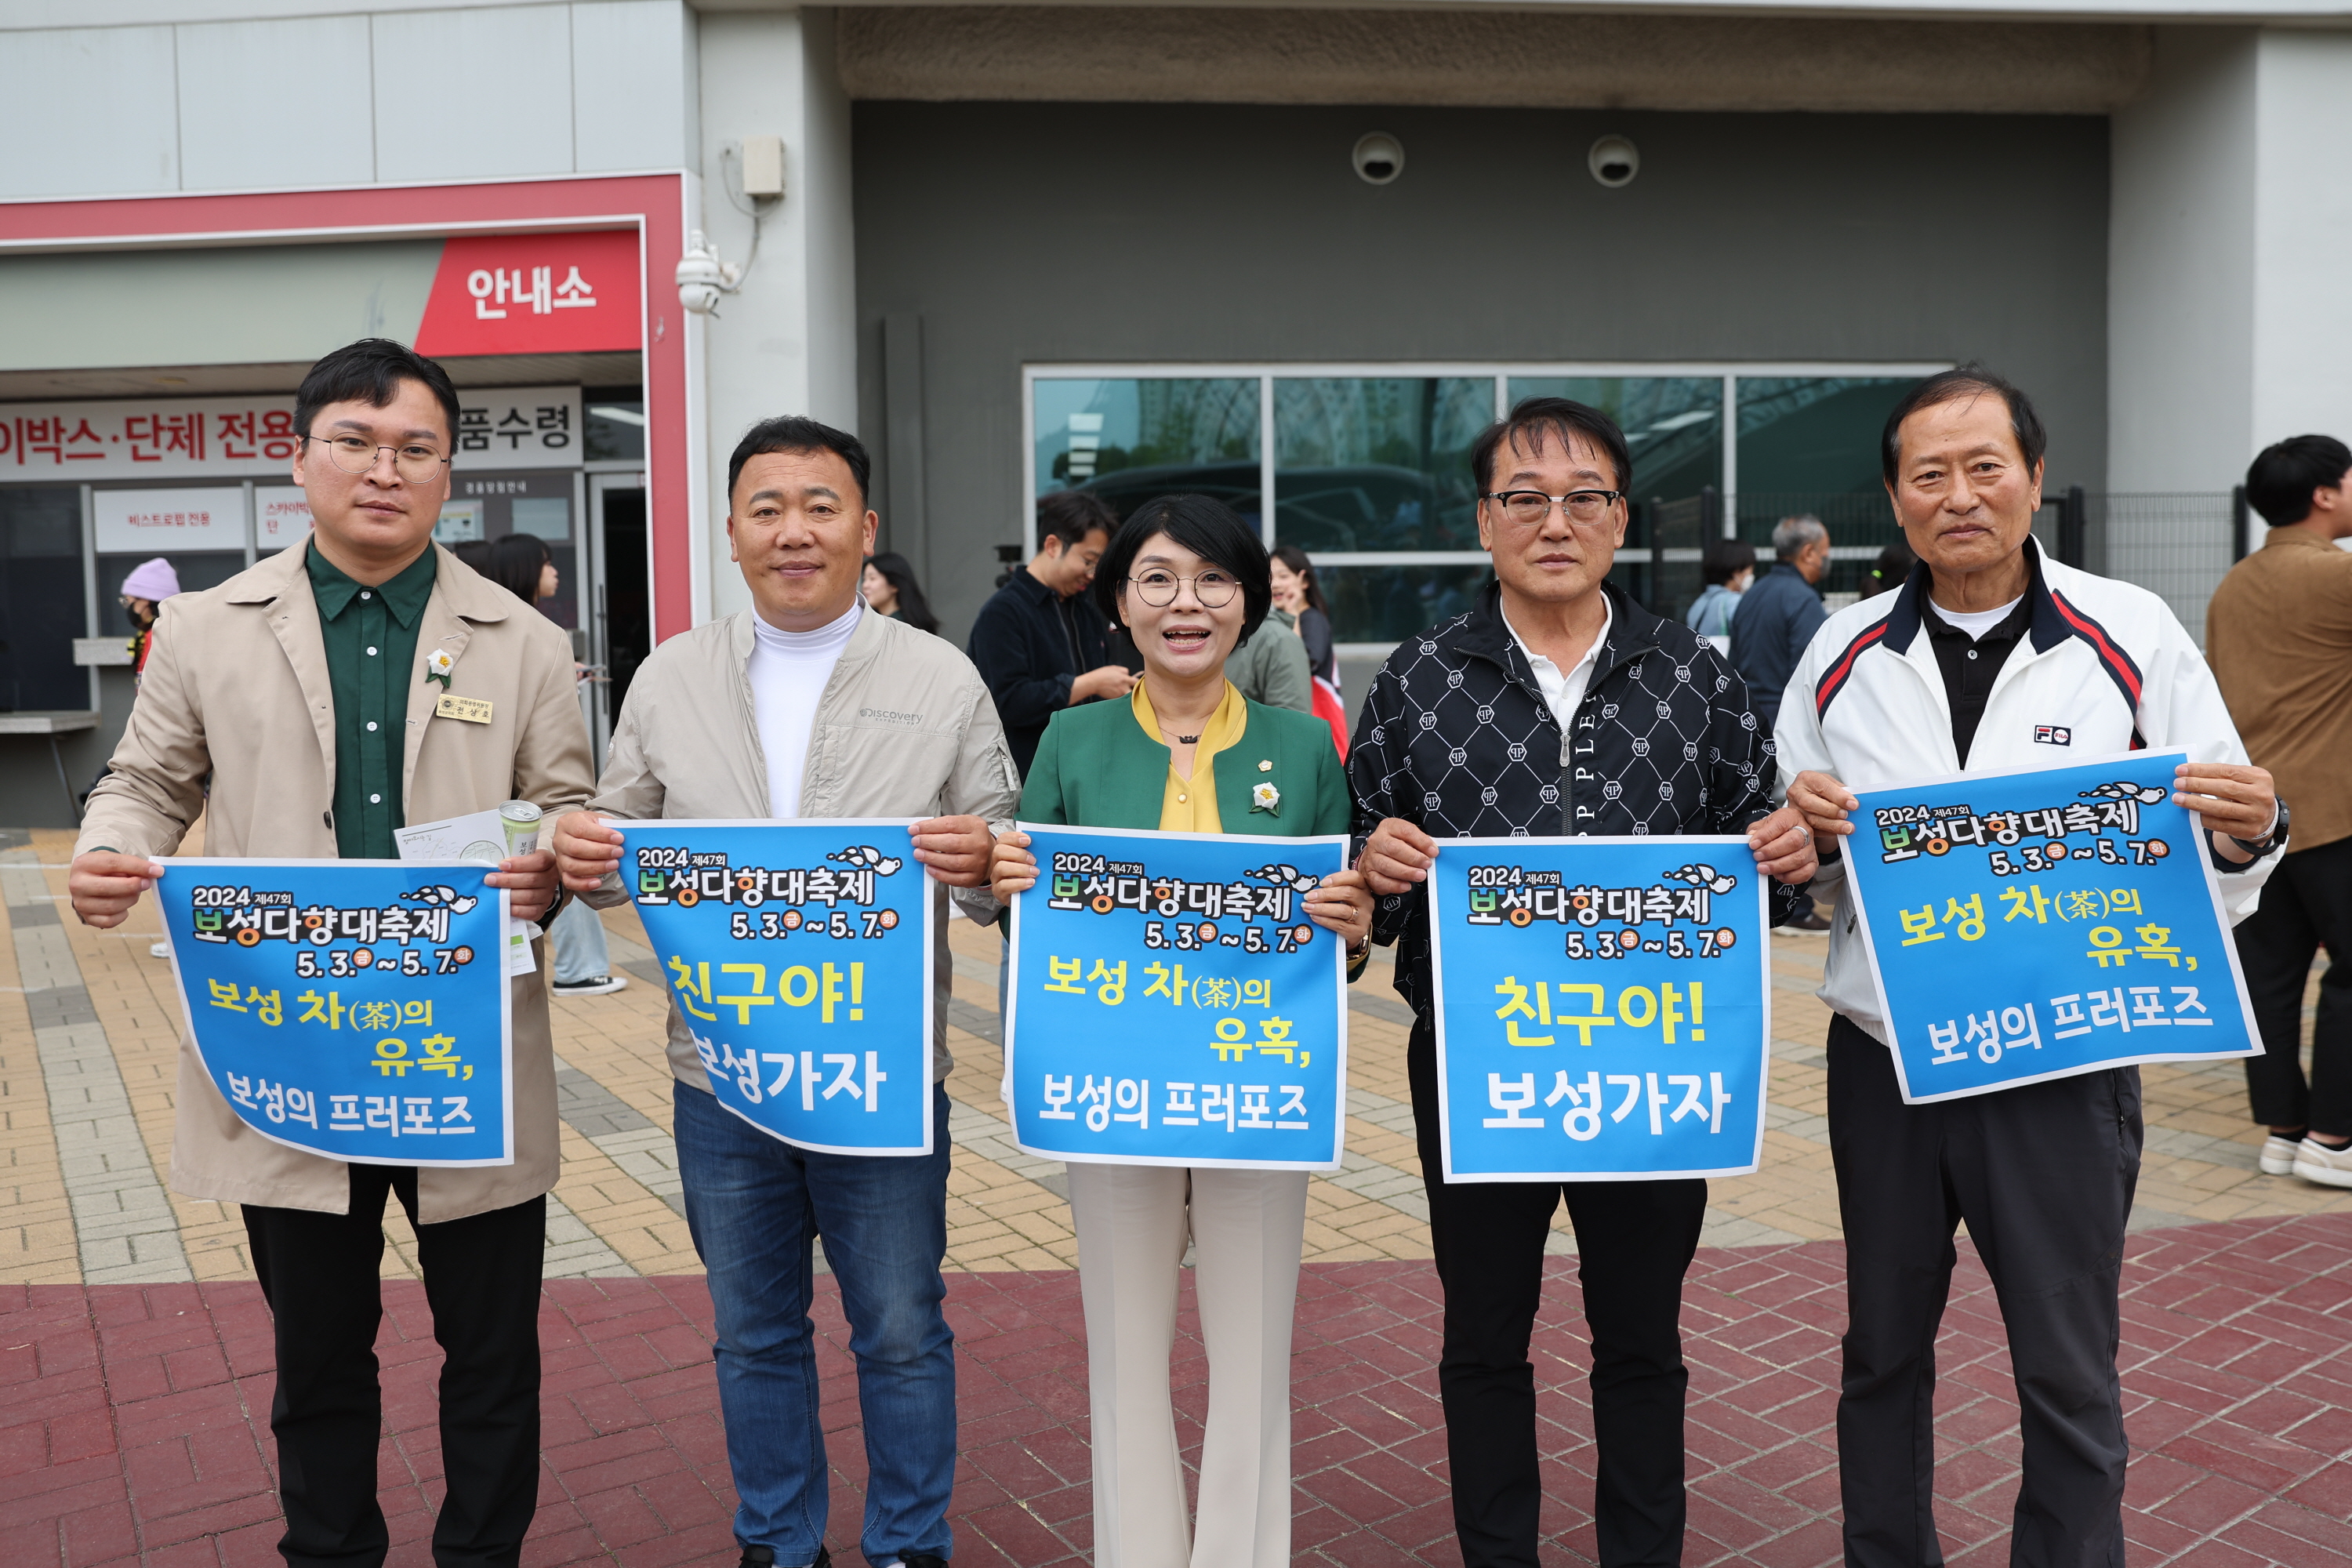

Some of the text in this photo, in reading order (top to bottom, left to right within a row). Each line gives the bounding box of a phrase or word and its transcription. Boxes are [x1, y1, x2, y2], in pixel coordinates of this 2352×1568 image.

[466, 264, 597, 320] 안내소
[216, 409, 295, 460] 전용
[460, 405, 571, 451] 품수령
[875, 717, 915, 726] EXPEDITION
[1876, 806, 1970, 826] 2024 제47회
[1881, 800, 2139, 863] 보성다향대축제
[637, 849, 727, 868] 2024 제47회
[1054, 854, 1143, 875] 2024 제47회
[1470, 867, 1560, 887] 2024 제47회
[193, 887, 292, 906] 2024 제47회
[637, 868, 874, 907] 보성다향대축제
[1049, 876, 1292, 922] 보성다향대축제
[1468, 887, 1709, 926] 보성다향대축제
[194, 906, 450, 946] 보성다향대축제
[1899, 892, 1986, 947] 보성
[2086, 922, 2198, 972] 유혹,
[208, 978, 284, 1027] 보성
[667, 955, 864, 1025] 친구야!
[1044, 955, 1127, 1006] 보성
[1494, 975, 1705, 1047] 친구야!
[1928, 985, 2214, 1065] 보성의 프러포즈
[371, 1033, 474, 1081] 유혹,
[1210, 1015, 1311, 1069] 유혹,
[688, 1026, 887, 1112] 보성가자
[227, 1071, 476, 1138] 보성의 프러포즈
[1039, 1073, 1309, 1133] 보성의 프러포즈
[1483, 1069, 1732, 1142] 보성가자
